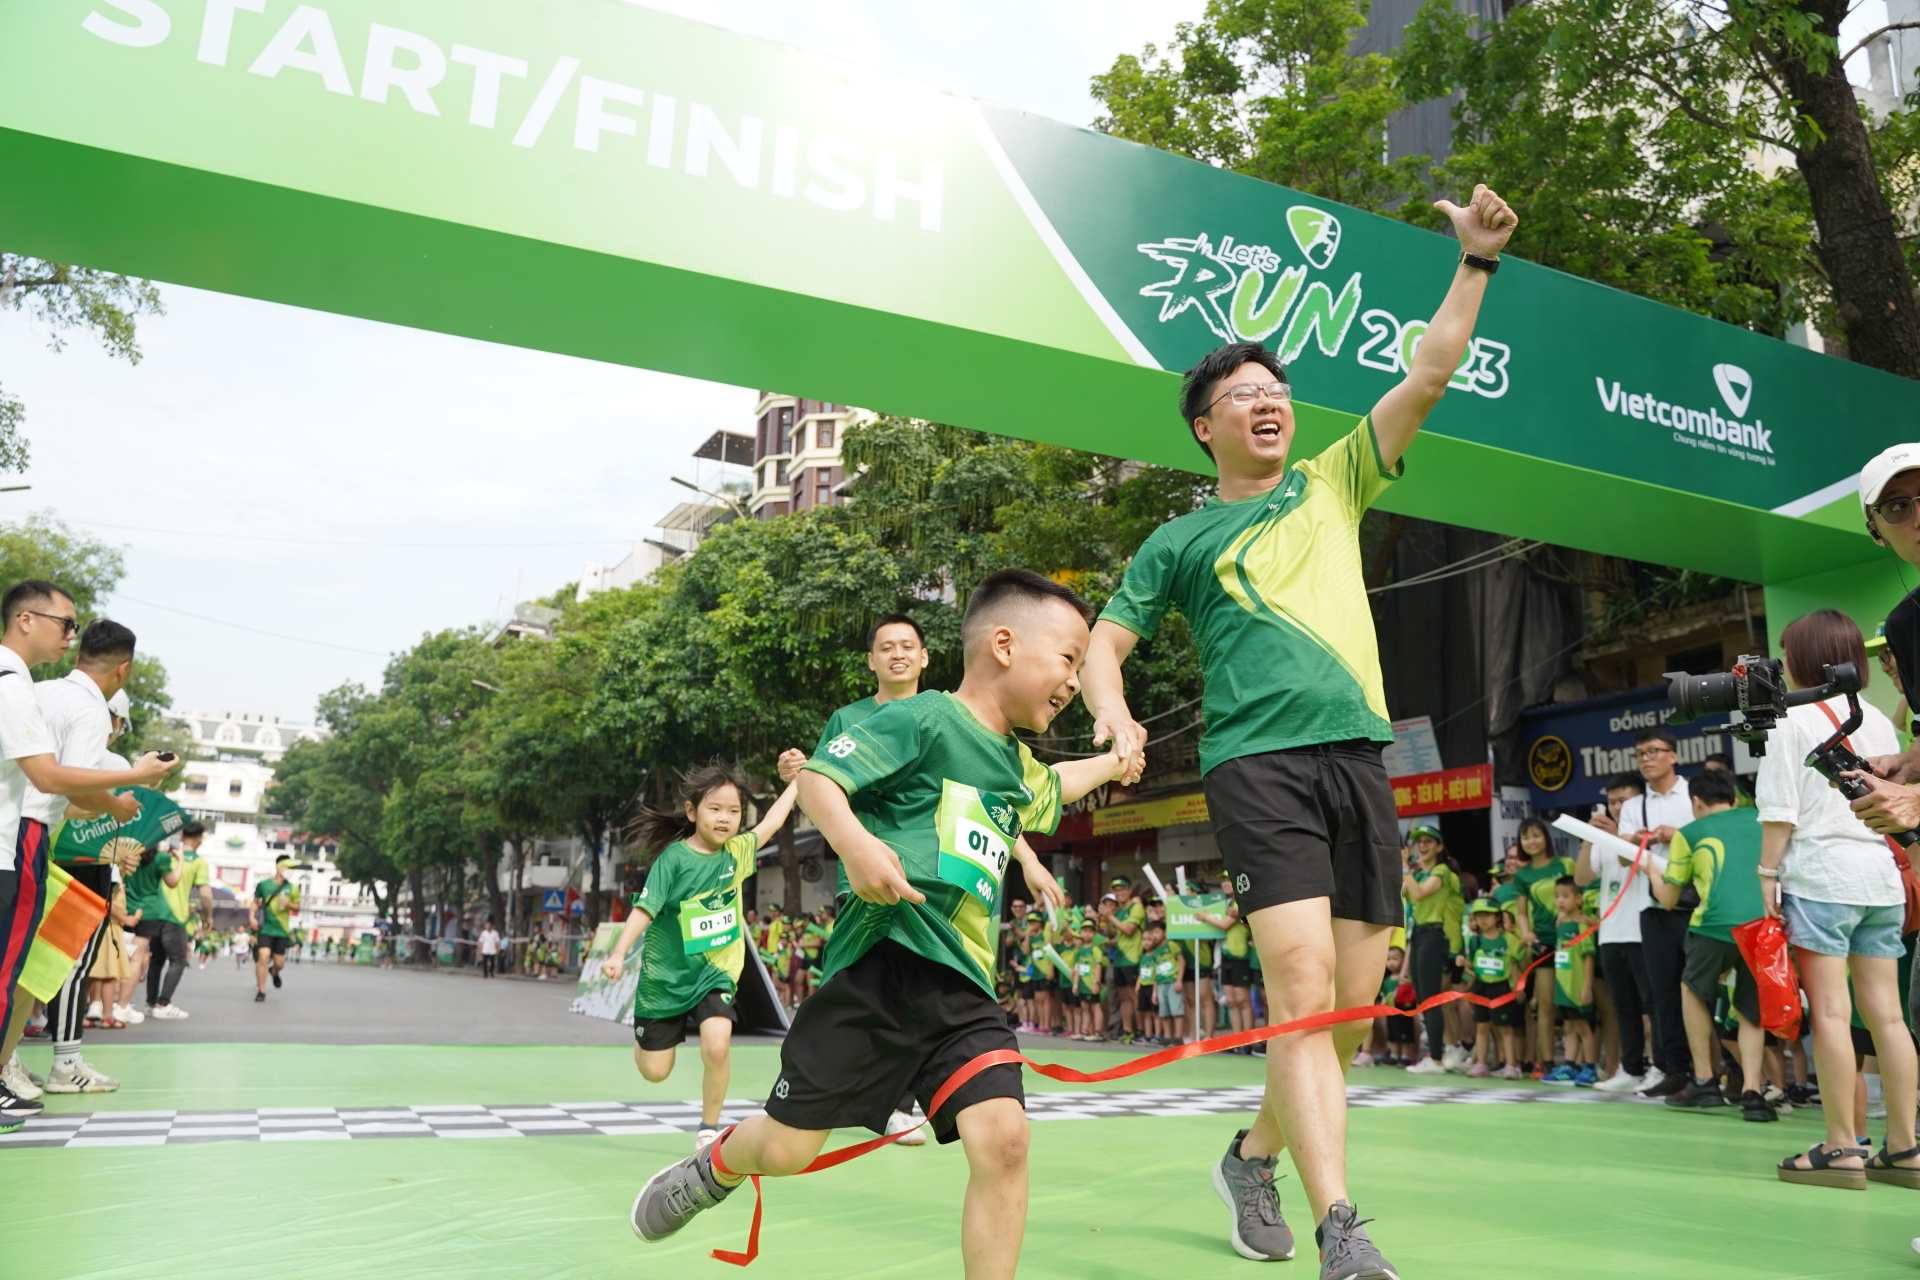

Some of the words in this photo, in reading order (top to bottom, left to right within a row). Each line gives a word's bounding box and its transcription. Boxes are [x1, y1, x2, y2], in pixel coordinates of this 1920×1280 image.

[1217, 235, 1281, 274] Let's
[1137, 233, 1362, 366] RUN
[1596, 376, 1774, 453] Vietcombank
[1673, 432, 1697, 447] Chung
[1659, 706, 1677, 725] H
[1580, 746, 1638, 777] Than
[73, 808, 142, 844] Unlimi
[968, 830, 989, 856] 01
[700, 919, 713, 931] 01
[723, 914, 732, 925] 10
